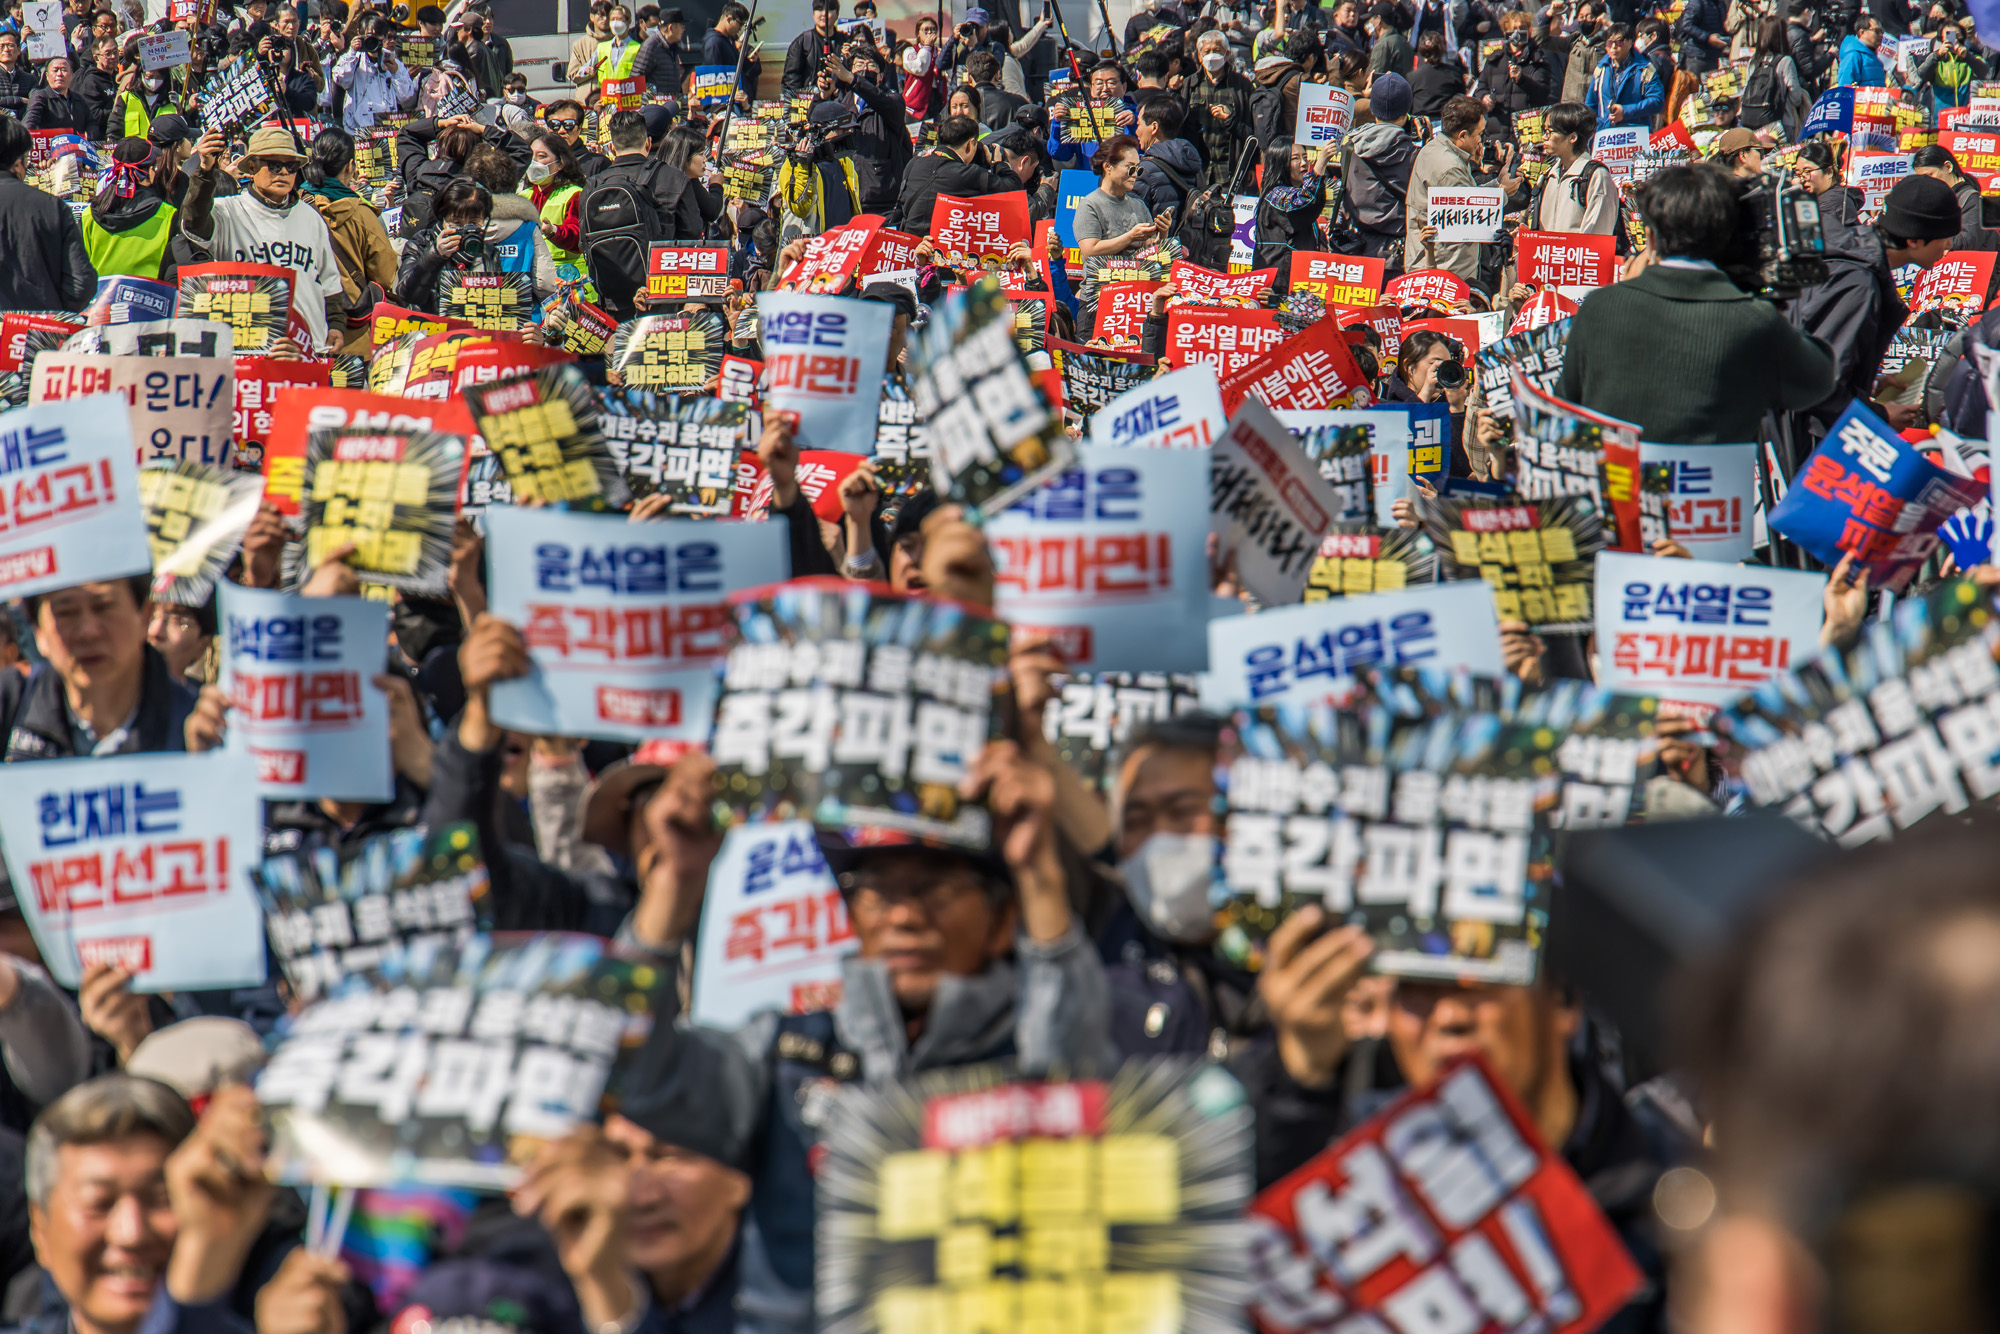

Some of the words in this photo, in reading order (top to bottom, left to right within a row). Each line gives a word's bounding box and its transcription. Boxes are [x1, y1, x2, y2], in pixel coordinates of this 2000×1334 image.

[231, 65, 259, 94] 윤석열
[606, 82, 636, 94] 윤석열
[1598, 131, 1637, 148] 윤석열은
[1952, 137, 1996, 153] 윤석열
[1861, 160, 1908, 176] 윤석열은
[1431, 196, 1466, 206] 내란동조
[948, 208, 1001, 232] 윤석열
[1430, 208, 1501, 230] 해체하라!
[835, 228, 870, 252] 파면
[937, 228, 972, 252] 즉각
[973, 232, 1010, 255] 구속
[660, 251, 717, 270] 윤석열
[1110, 260, 1137, 269] 내란수괴
[1532, 244, 1601, 268] 새봄에는
[464, 276, 497, 287] 내란수괴
[1175, 266, 1231, 288] 윤석열
[1230, 273, 1268, 287] 파면
[1308, 259, 1365, 284] 윤석열
[1531, 263, 1600, 286] 새나라로
[1919, 261, 1978, 287] 새봄에는
[649, 276, 687, 295] 파면
[1180, 279, 1216, 297] 빛의
[1218, 284, 1255, 297] 혁명
[1396, 285, 1457, 303] 새나라로
[1397, 275, 1459, 292] 새봄에는
[1916, 276, 1973, 304] 새나라로
[193, 292, 272, 313] 윤석열을
[452, 286, 518, 305] 윤석열을
[1112, 291, 1154, 314] 윤석열
[1331, 284, 1377, 308] 파면!
[761, 311, 848, 347] 석열은
[1102, 312, 1132, 335] 즉각
[1372, 316, 1401, 336] 파면
[233, 326, 269, 347] 하라
[1174, 322, 1238, 351] 윤석열
[626, 364, 707, 384] 파면하라
[1068, 363, 1114, 389] 내란수괴
[145, 371, 226, 412] 온다!
[680, 422, 737, 449] 윤석열
[1837, 416, 1900, 484] 주문
[534, 541, 724, 594] 윤석열은
[1622, 582, 1774, 626] 윤석열은
[1243, 610, 1439, 700] 윤석열은
[1612, 630, 1790, 682] 즉각파면!
[39, 782, 182, 850] 헌재는
[1222, 810, 1529, 925] 즉각파면
